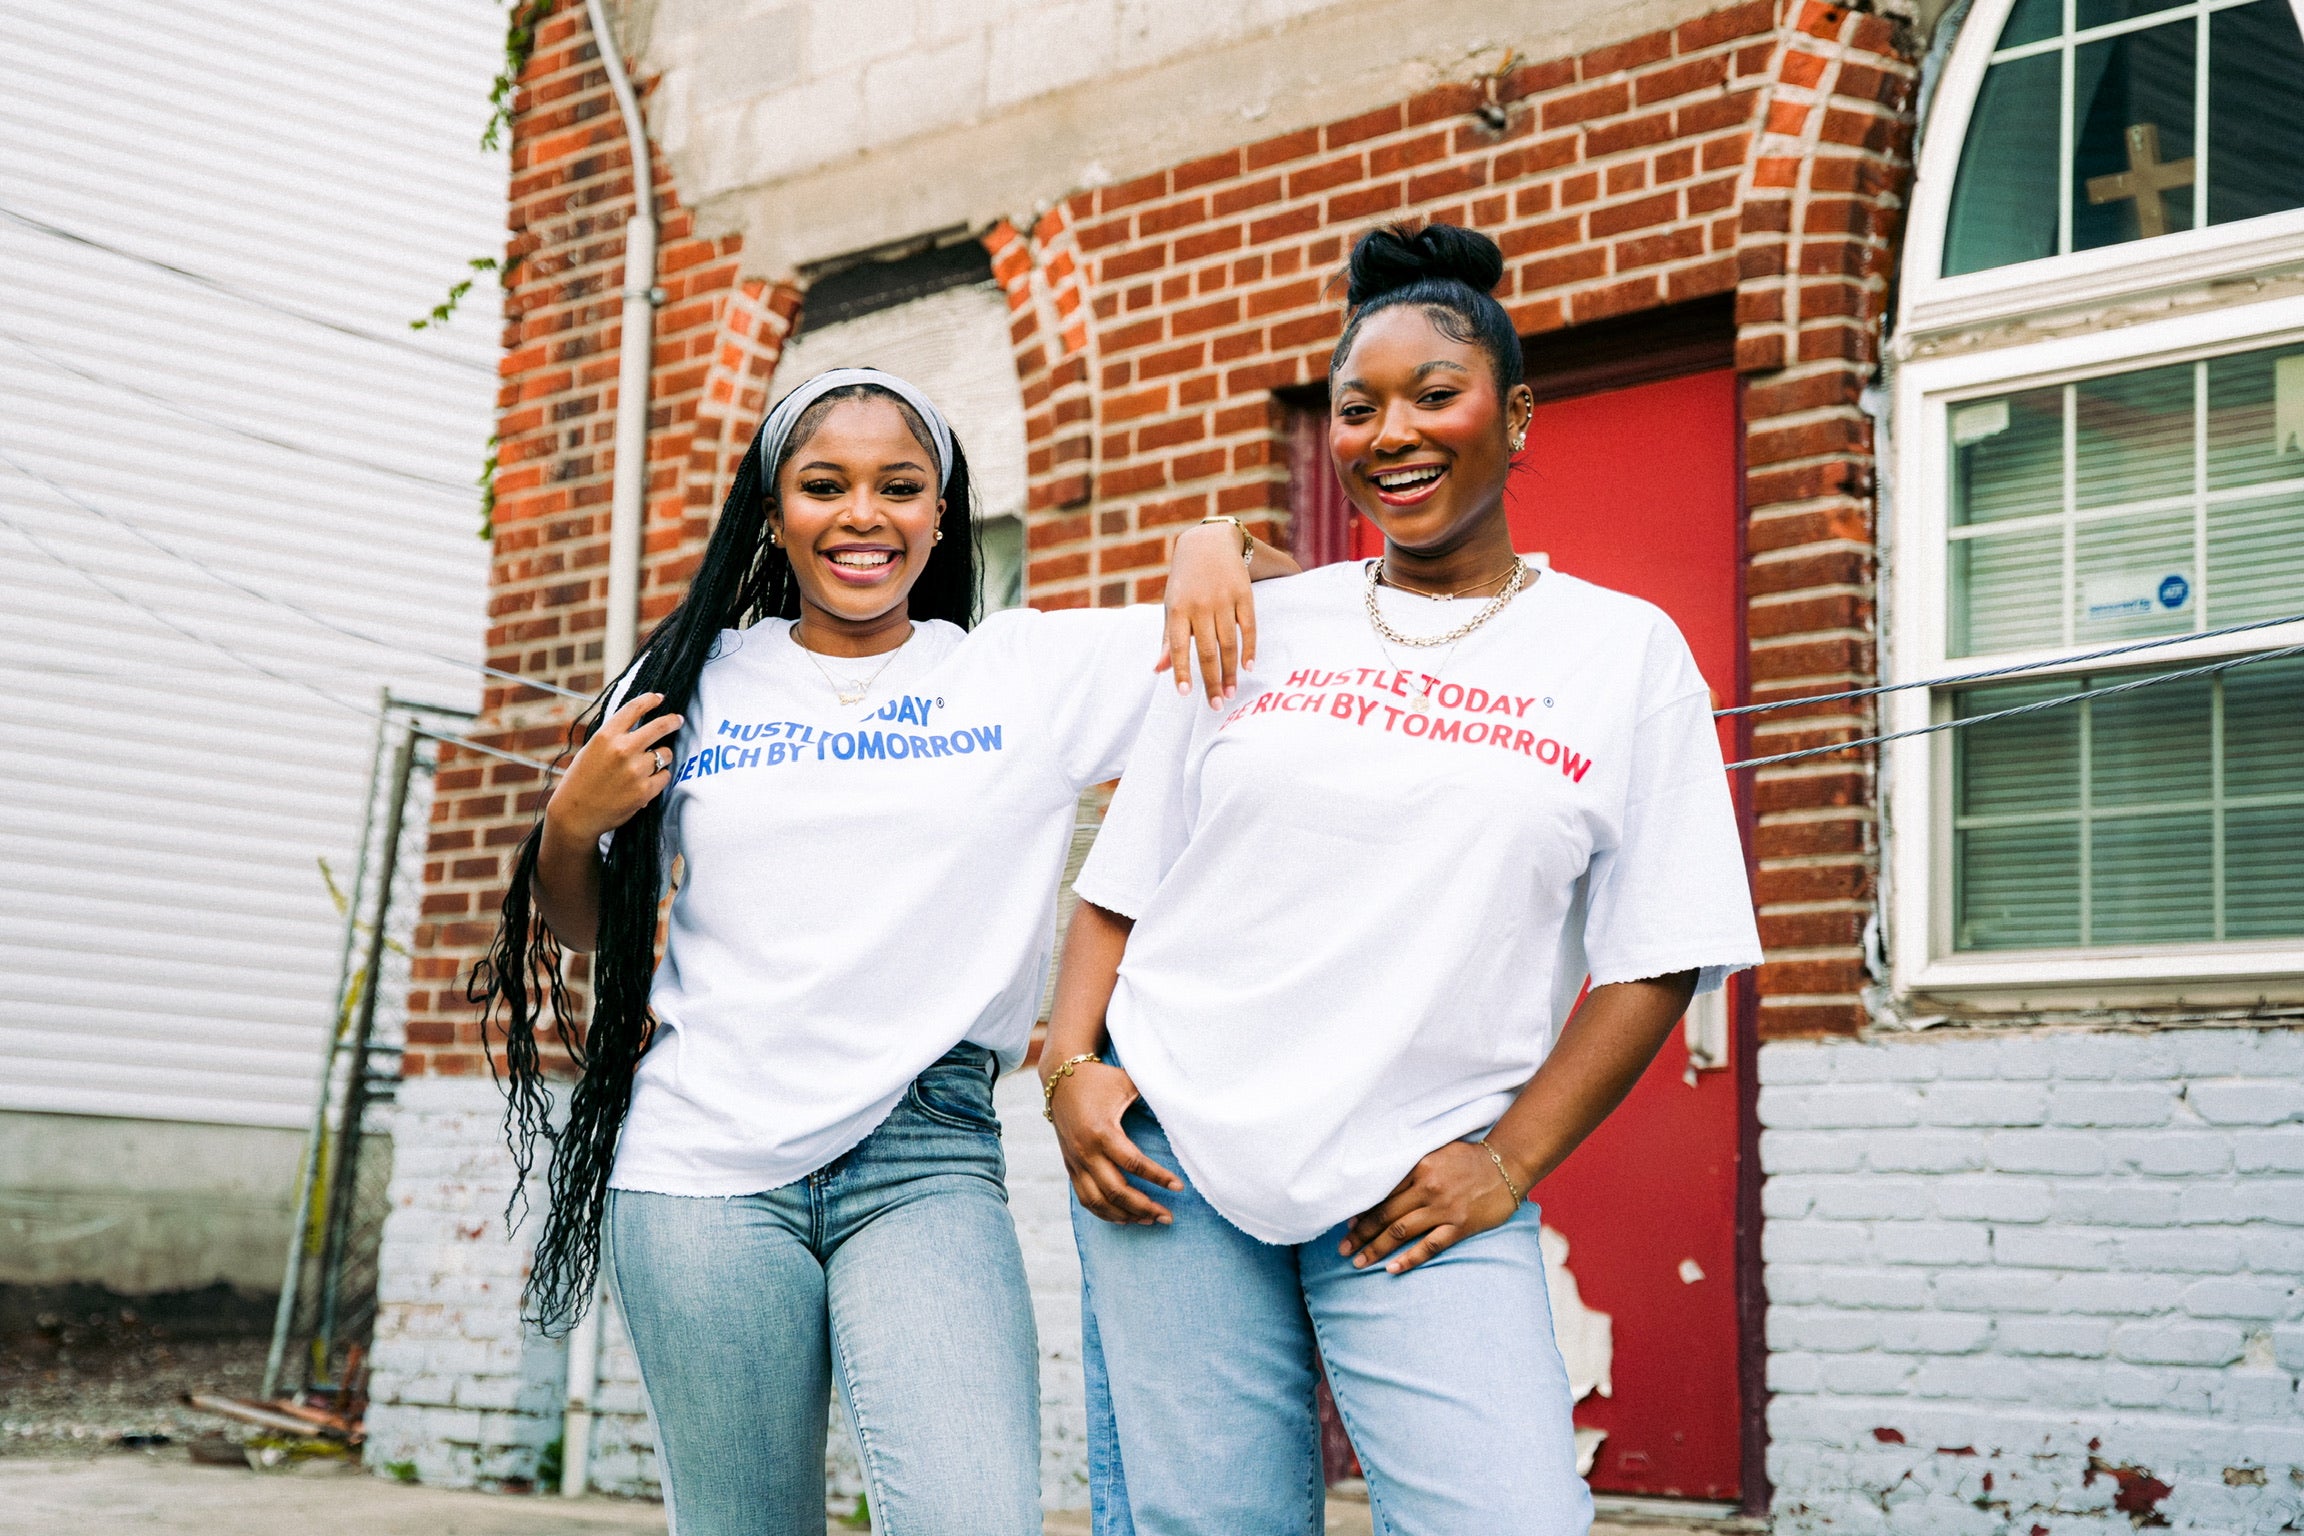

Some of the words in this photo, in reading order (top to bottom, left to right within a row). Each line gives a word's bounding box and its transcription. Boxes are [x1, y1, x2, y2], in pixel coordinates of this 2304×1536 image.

[1285, 668, 1413, 697] HUSTLE
[1421, 674, 1536, 718] TODAY
[697, 745, 761, 777] RICH
[766, 742, 807, 766] BY
[817, 725, 1002, 761] TOMORROW
[717, 719, 815, 744] HUSTL
[1251, 692, 1328, 716] RICH
[1330, 692, 1379, 727] BY
[1384, 705, 1592, 784] TOMORROW
